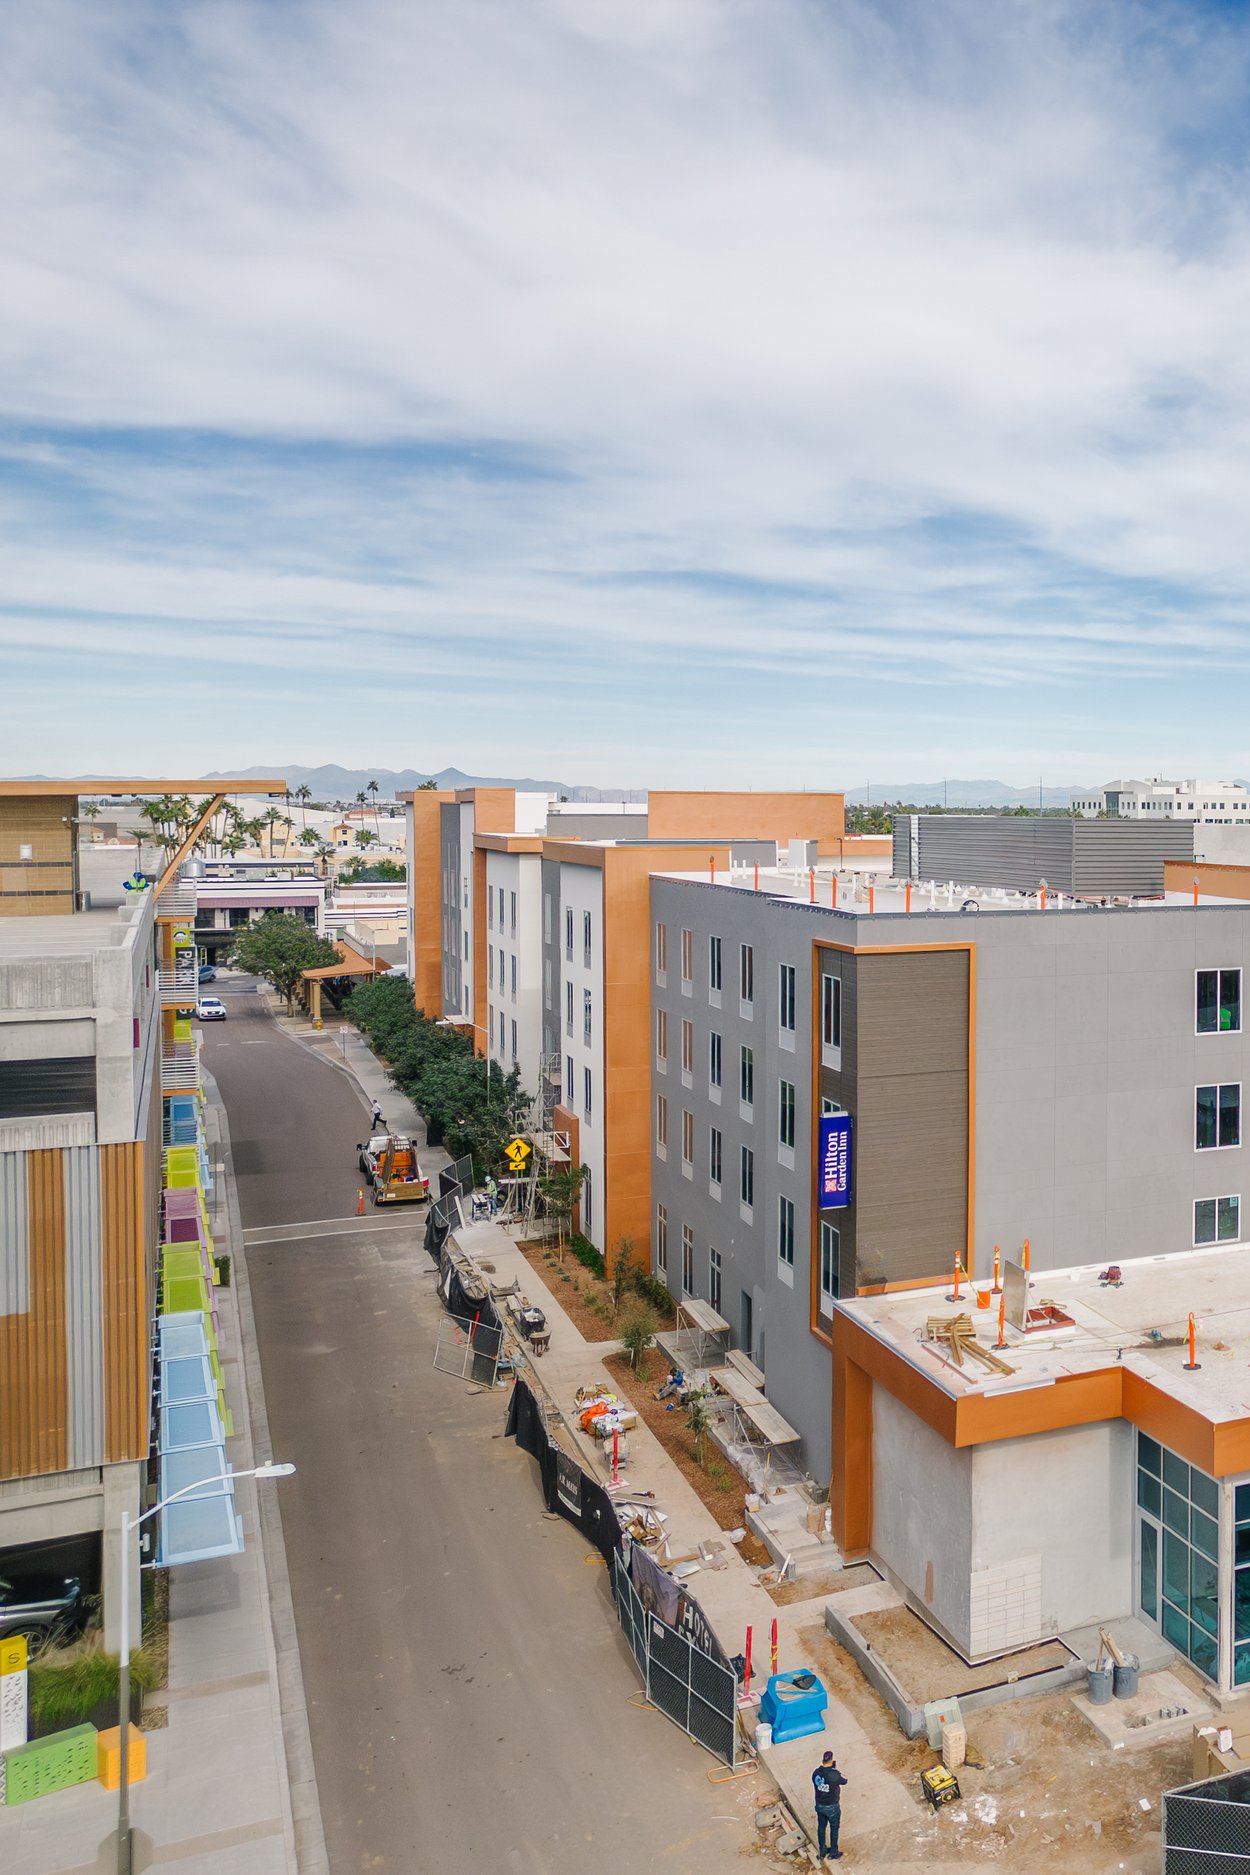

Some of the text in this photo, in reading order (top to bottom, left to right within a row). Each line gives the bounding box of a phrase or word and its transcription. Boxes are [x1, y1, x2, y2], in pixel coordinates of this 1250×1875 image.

[825, 1132, 838, 1180] Hilton
[837, 1131, 847, 1192] Garden Inn
